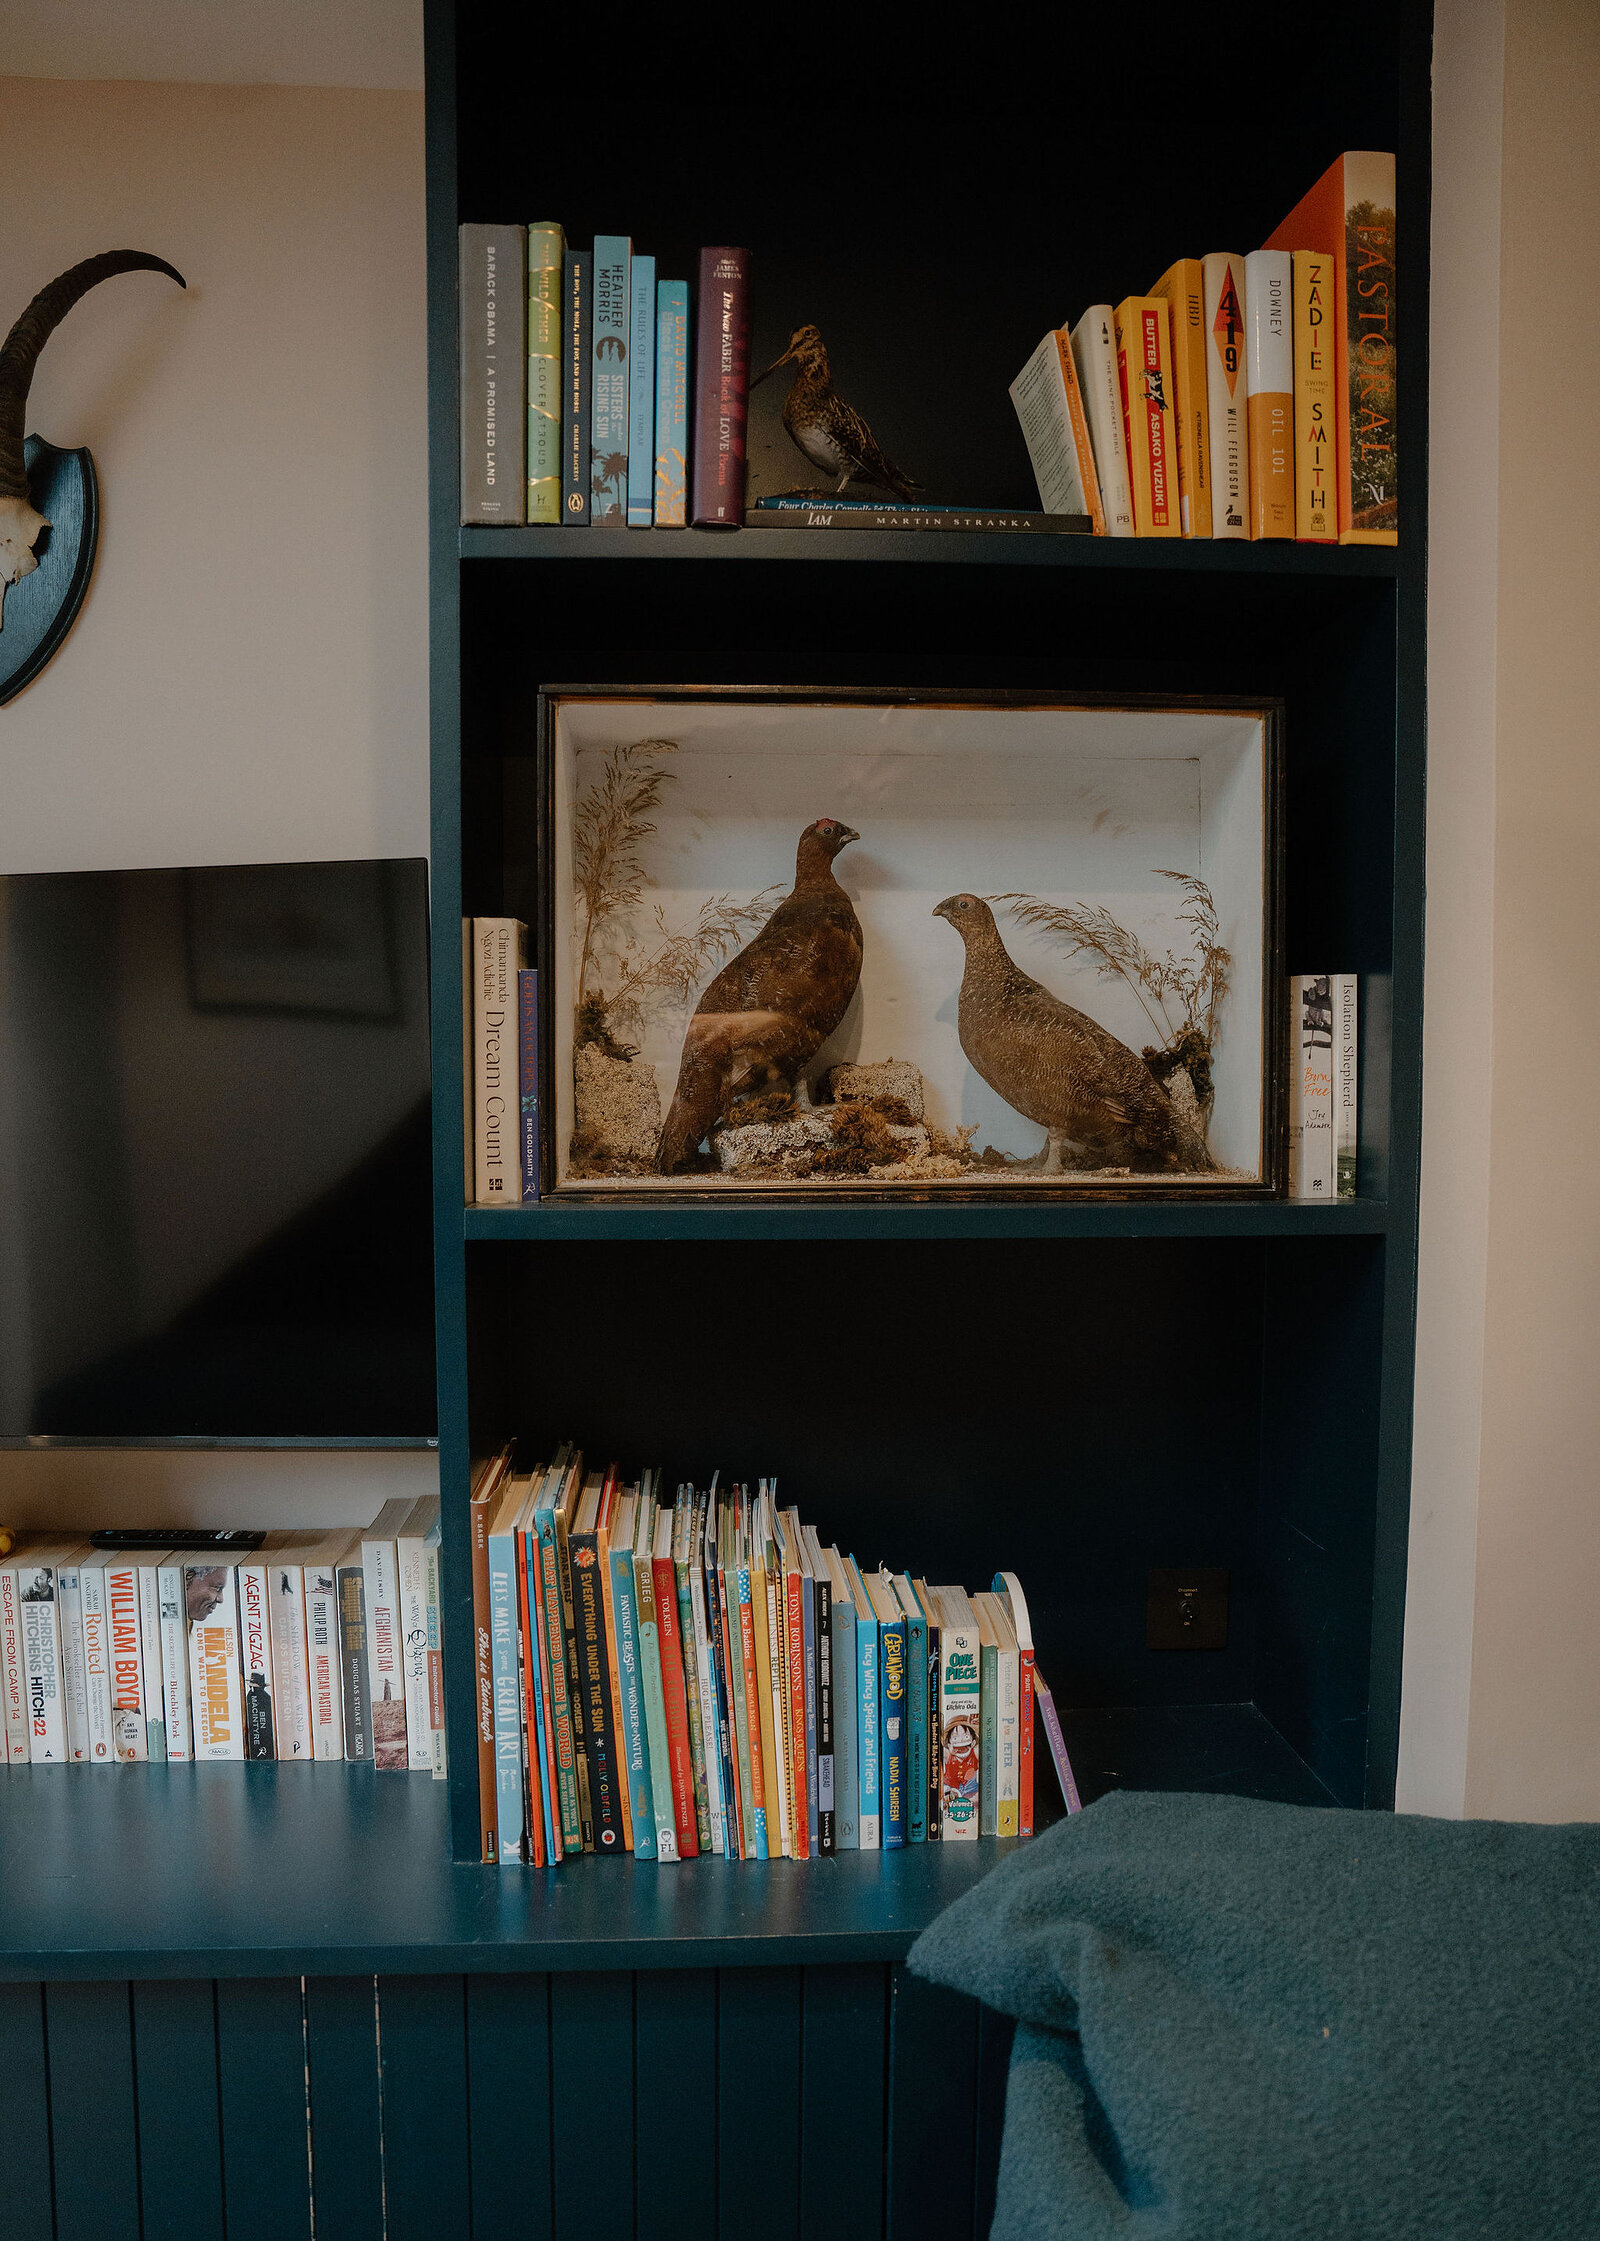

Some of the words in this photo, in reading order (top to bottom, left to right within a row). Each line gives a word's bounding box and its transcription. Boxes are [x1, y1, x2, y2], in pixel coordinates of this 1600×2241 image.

[486, 246, 496, 297] BARACK
[538, 270, 549, 299] WILD
[713, 271, 742, 280] FENTON
[598, 268, 611, 323] MORRIS
[611, 264, 624, 328] HEATHER
[638, 287, 647, 304] THE
[723, 291, 734, 310] The
[1269, 280, 1283, 336] DOWNEY
[486, 301, 496, 346] OBAMA
[538, 305, 549, 343] OTHER
[637, 309, 646, 340] RULES
[1219, 290, 1237, 373] 419
[1308, 265, 1323, 370] ZADIE
[638, 343, 646, 359] OF
[675, 315, 686, 357] DAVID
[721, 333, 733, 373] FABER
[1145, 318, 1157, 366] BUTTER
[1357, 226, 1391, 461] PASTORAL
[486, 367, 496, 376] A
[538, 358, 547, 407] CLOVER
[637, 361, 646, 379] LIFE
[597, 374, 610, 412] RISING
[610, 374, 624, 421] SISTERS
[674, 360, 686, 425] MITCHELL
[720, 376, 732, 402] Book
[486, 381, 496, 447] PROMISED
[597, 416, 609, 438] SUN
[1227, 408, 1237, 433] WILL
[1271, 408, 1284, 436] OIL
[538, 414, 546, 466] STROUD
[719, 417, 730, 451] LOVE
[1150, 412, 1162, 457] ASAKO
[486, 452, 496, 486] LAND
[1228, 440, 1239, 498] FERGUSON
[1272, 448, 1285, 475] 101
[1308, 403, 1327, 509] SMITH
[1153, 460, 1164, 507] YUZUKI
[876, 517, 942, 525] MARTIN
[953, 518, 1031, 527] STRANKA
[1116, 514, 1130, 524] PB
[480, 930, 494, 960] Ngozi
[483, 963, 495, 1001] Adichie
[498, 928, 510, 1003] Chimamanda
[1343, 984, 1354, 1040] Isolation
[485, 1011, 506, 1088] Dream
[1304, 1067, 1331, 1082] Born
[1304, 1082, 1331, 1097] Free
[1340, 1046, 1354, 1107] Shepherd
[486, 1096, 506, 1169] Count
[1308, 1109, 1326, 1120] Joy
[542, 1545, 556, 1586] WHAT
[560, 1545, 569, 1575] STAR
[1, 1575, 14, 1626] ESCAPE
[84, 1577, 92, 1611] LANGFORD
[244, 1574, 260, 1618] AGENT
[427, 1568, 437, 1604] BACKYARD
[562, 1576, 573, 1605] WARS
[640, 1571, 652, 1604] GRIEG
[109, 1571, 137, 1654] WILLIAM
[313, 1602, 326, 1626] PHILIP
[546, 1587, 564, 1660] HAPPENED
[580, 1572, 598, 1641] EVERYTHING
[619, 1593, 632, 1641] FANTASTIC
[661, 1595, 672, 1637] TOLKIEN
[741, 1610, 750, 1625] The
[767, 1588, 778, 1655] EYEWITNESS
[788, 1591, 799, 1621] TONY
[26, 1605, 42, 1673] HITCHENS
[86, 1613, 105, 1675] Rooted
[226, 1627, 234, 1658] NELSON
[315, 1626, 328, 1646] ROTH
[374, 1607, 394, 1673] AFGHANISTAN
[426, 1606, 438, 1650] SHEEP
[478, 1627, 490, 1660] This
[494, 1607, 511, 1645] MAKE
[742, 1626, 751, 1659] Baddies
[5, 1629, 17, 1665] FROM
[38, 1604, 57, 1700] CHRISTOPHER
[72, 1637, 83, 1679] Bookseller
[248, 1622, 264, 1669] ZIGZAG
[291, 1625, 300, 1669] SHADOW
[406, 1629, 427, 1681] Qigong
[567, 1637, 578, 1680] WHERE'S
[789, 1625, 802, 1692] ROBINSON'S
[820, 1635, 829, 1659] ANTHONY
[863, 1643, 875, 1667] Incy
[950, 1653, 974, 1667] ONE
[281, 1661, 289, 1684] RUIZ
[316, 1655, 331, 1689] AMERICAN
[351, 1658, 360, 1694] DOUGLAS
[587, 1646, 600, 1683] UNDER
[770, 1656, 779, 1692] REPTILE
[820, 1660, 830, 1686] HOROWITZ
[883, 1633, 904, 1700] GRIMWOOD
[945, 1667, 978, 1681] PIECE
[8, 1668, 20, 1705] CAMP
[114, 1659, 140, 1710] BOYD
[169, 1681, 178, 1718] Bletchley
[199, 1685, 207, 1697] TO
[204, 1627, 231, 1745] MANDELA
[496, 1676, 518, 1724] GREAT
[551, 1663, 566, 1703] WHEN
[589, 1684, 602, 1704] THE
[700, 1678, 708, 1696] HUG
[806, 1679, 815, 1713] Colouring
[863, 1669, 875, 1700] Wincy
[11, 1707, 21, 1720] 14
[201, 1701, 209, 1745] FREEDOM
[251, 1695, 260, 1745] MACINTYRE
[295, 1702, 304, 1732] WIND
[318, 1690, 332, 1726] PASTORAL
[353, 1696, 361, 1727] STUART
[480, 1677, 494, 1743] Edinburgh
[591, 1705, 605, 1733] SUN
[628, 1687, 641, 1729] WONDER
[749, 1683, 757, 1731] DONALDSON
[794, 1708, 803, 1731] KINGS
[862, 1702, 875, 1735] Spider
[496, 1731, 520, 1763] ART
[556, 1715, 573, 1769] WORLD
[631, 1734, 643, 1771] NATURE
[793, 1737, 805, 1772] QUEENS
[864, 1738, 876, 1756] and
[1004, 1742, 1013, 1768] PETER
[597, 1753, 608, 1783] MOLLY
[752, 1755, 762, 1801] SCHEFFLER
[822, 1757, 831, 1788] SNAKEHEAD
[864, 1760, 877, 1795] Friends
[889, 1756, 899, 1785] NADIA
[600, 1783, 611, 1824] OLDFIELD
[679, 1778, 687, 1800] DAVID
[889, 1786, 900, 1822] SHIREEN
[948, 1800, 974, 1808] Volumes
[681, 1801, 689, 1827] WENZEL
